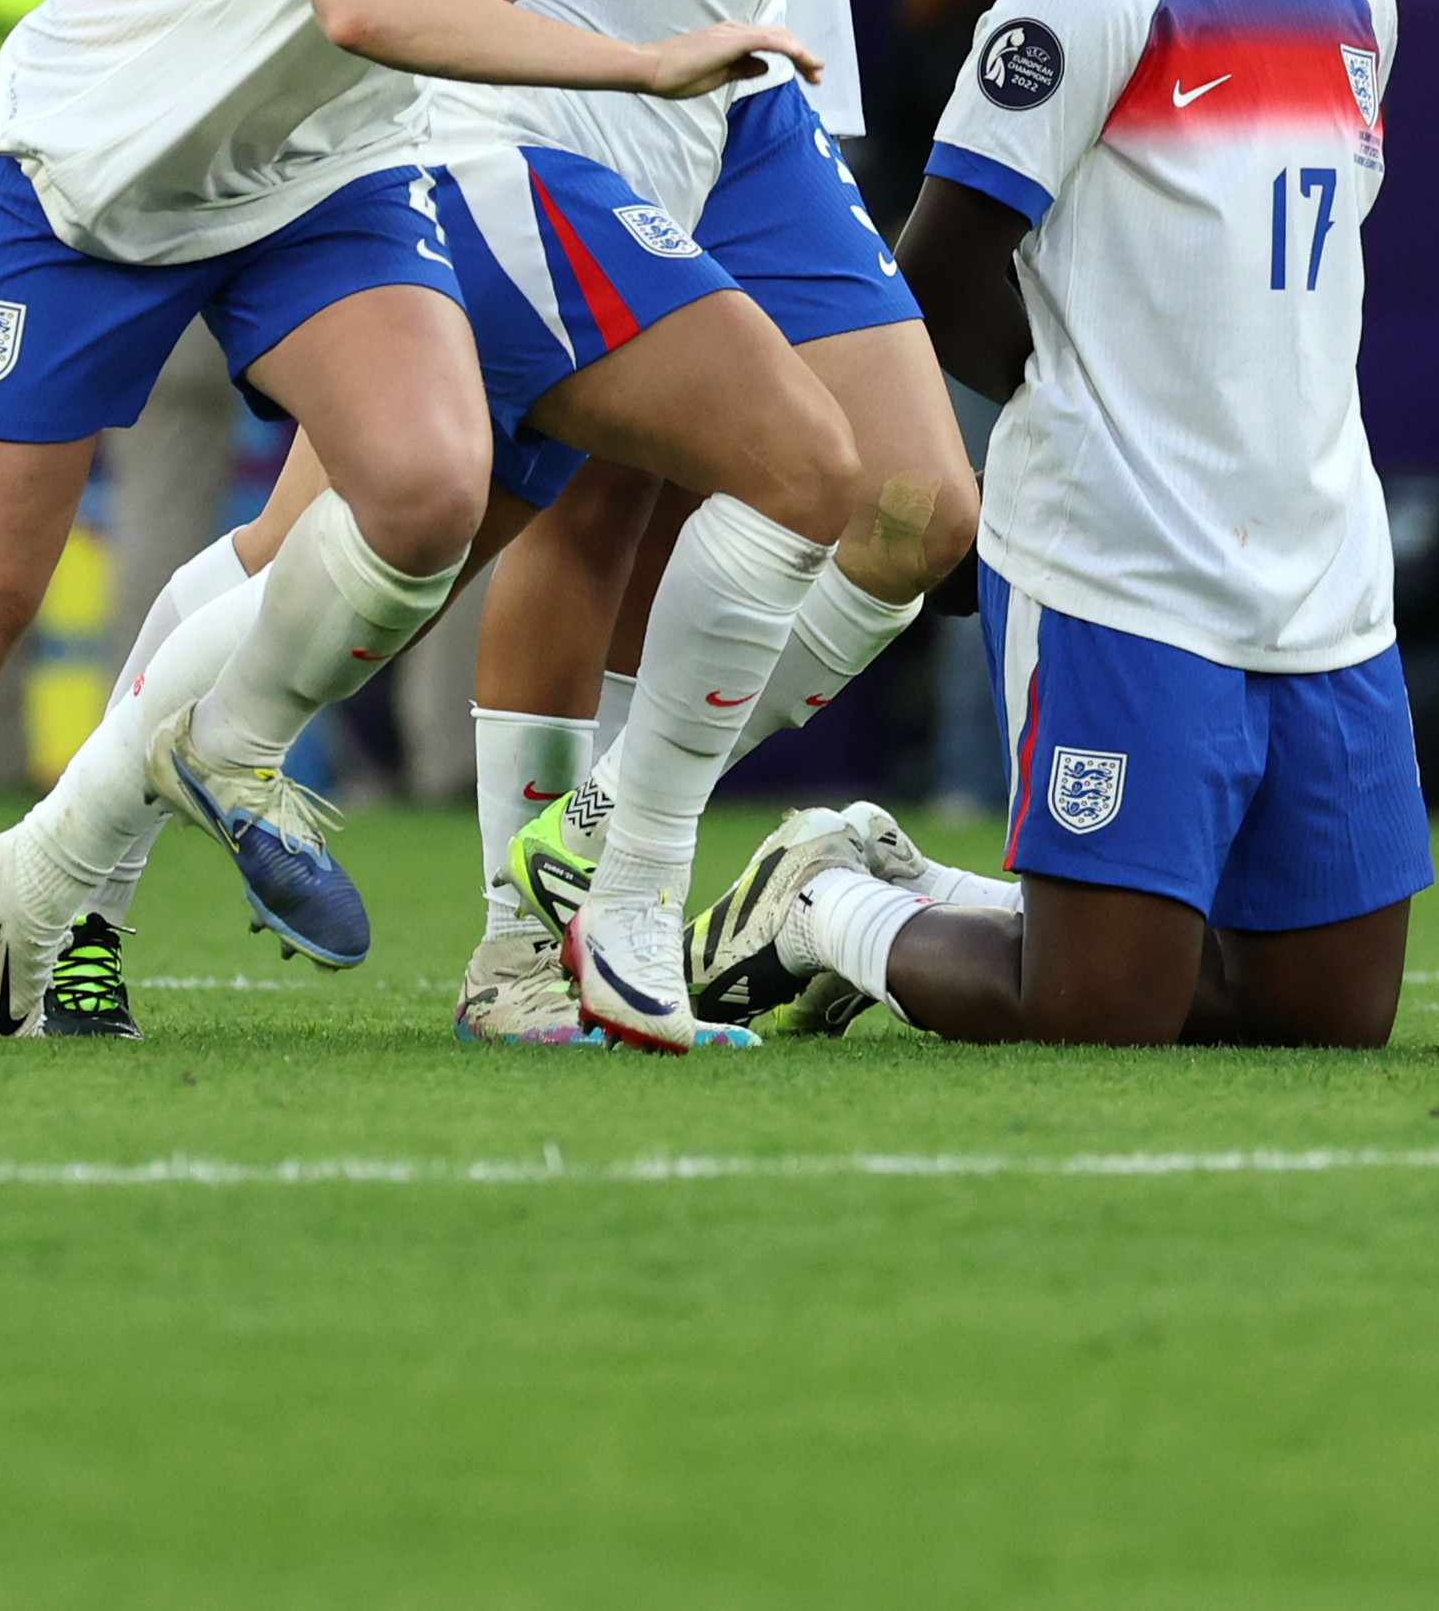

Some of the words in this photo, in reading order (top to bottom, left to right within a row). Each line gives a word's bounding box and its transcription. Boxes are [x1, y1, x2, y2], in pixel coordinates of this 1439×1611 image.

[1013, 54, 1054, 77] EUROPEAN
[1026, 46, 1050, 63] UEFA
[1008, 61, 1053, 86] CHAMPIONS
[1011, 74, 1039, 93] 2022
[1270, 167, 1336, 291] 17
